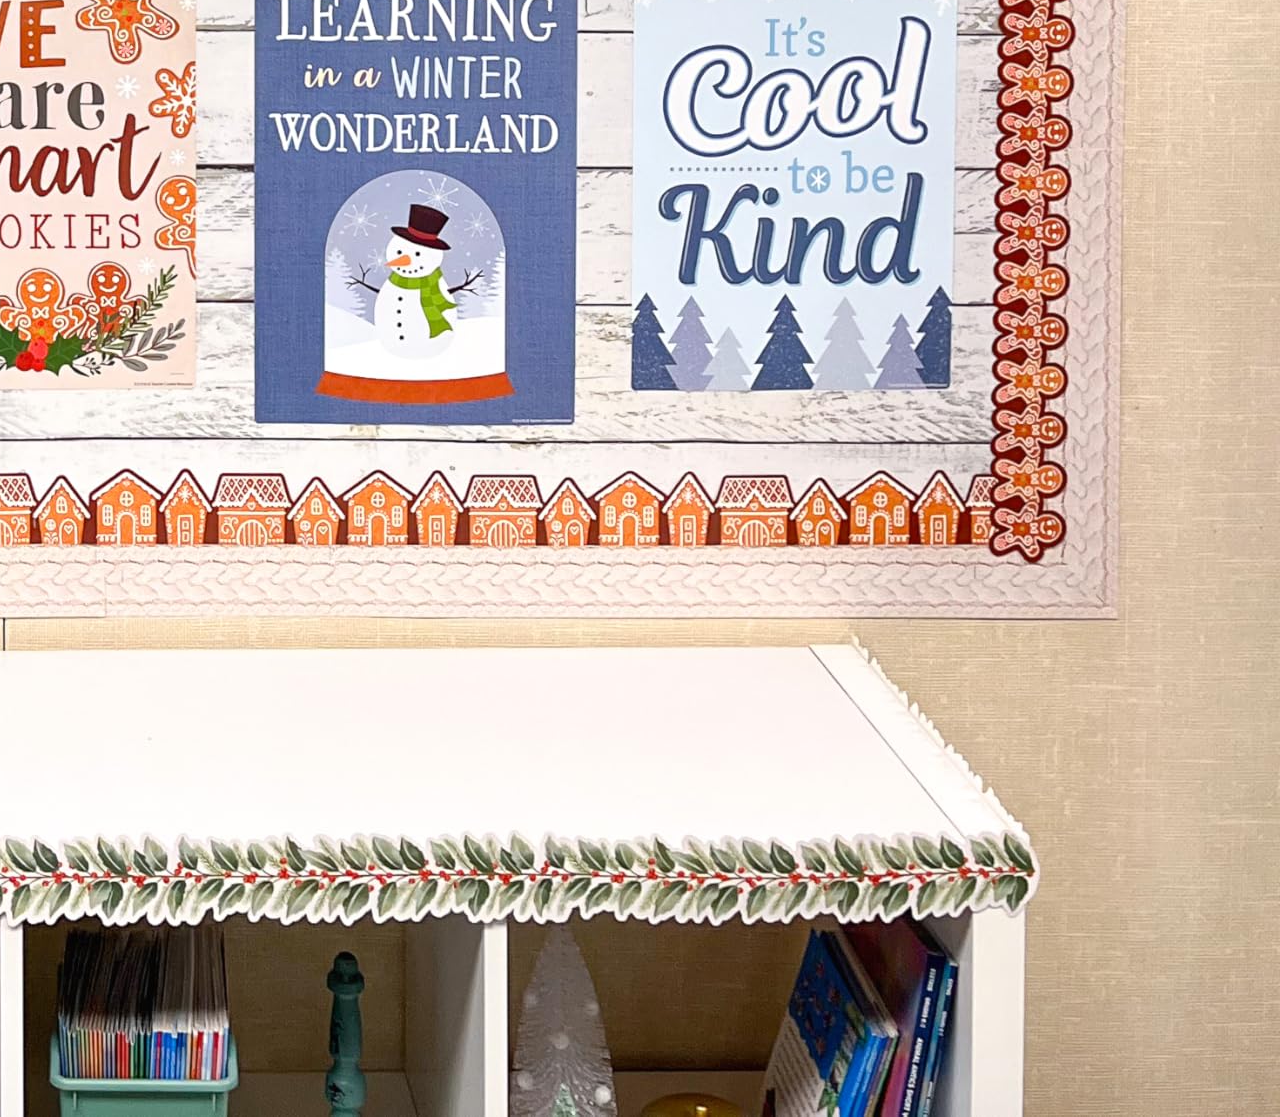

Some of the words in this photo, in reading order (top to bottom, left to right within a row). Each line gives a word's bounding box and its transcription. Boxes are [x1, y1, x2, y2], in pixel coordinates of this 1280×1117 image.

[764, 17, 826, 58] It's
[303, 63, 343, 89] in
[353, 66, 381, 89] a
[391, 55, 523, 100] WINTER
[662, 15, 933, 158] Cool
[269, 113, 560, 154] WONDERLAND
[787, 156, 831, 195] to
[841, 150, 896, 194] be
[658, 171, 924, 287] Kind
